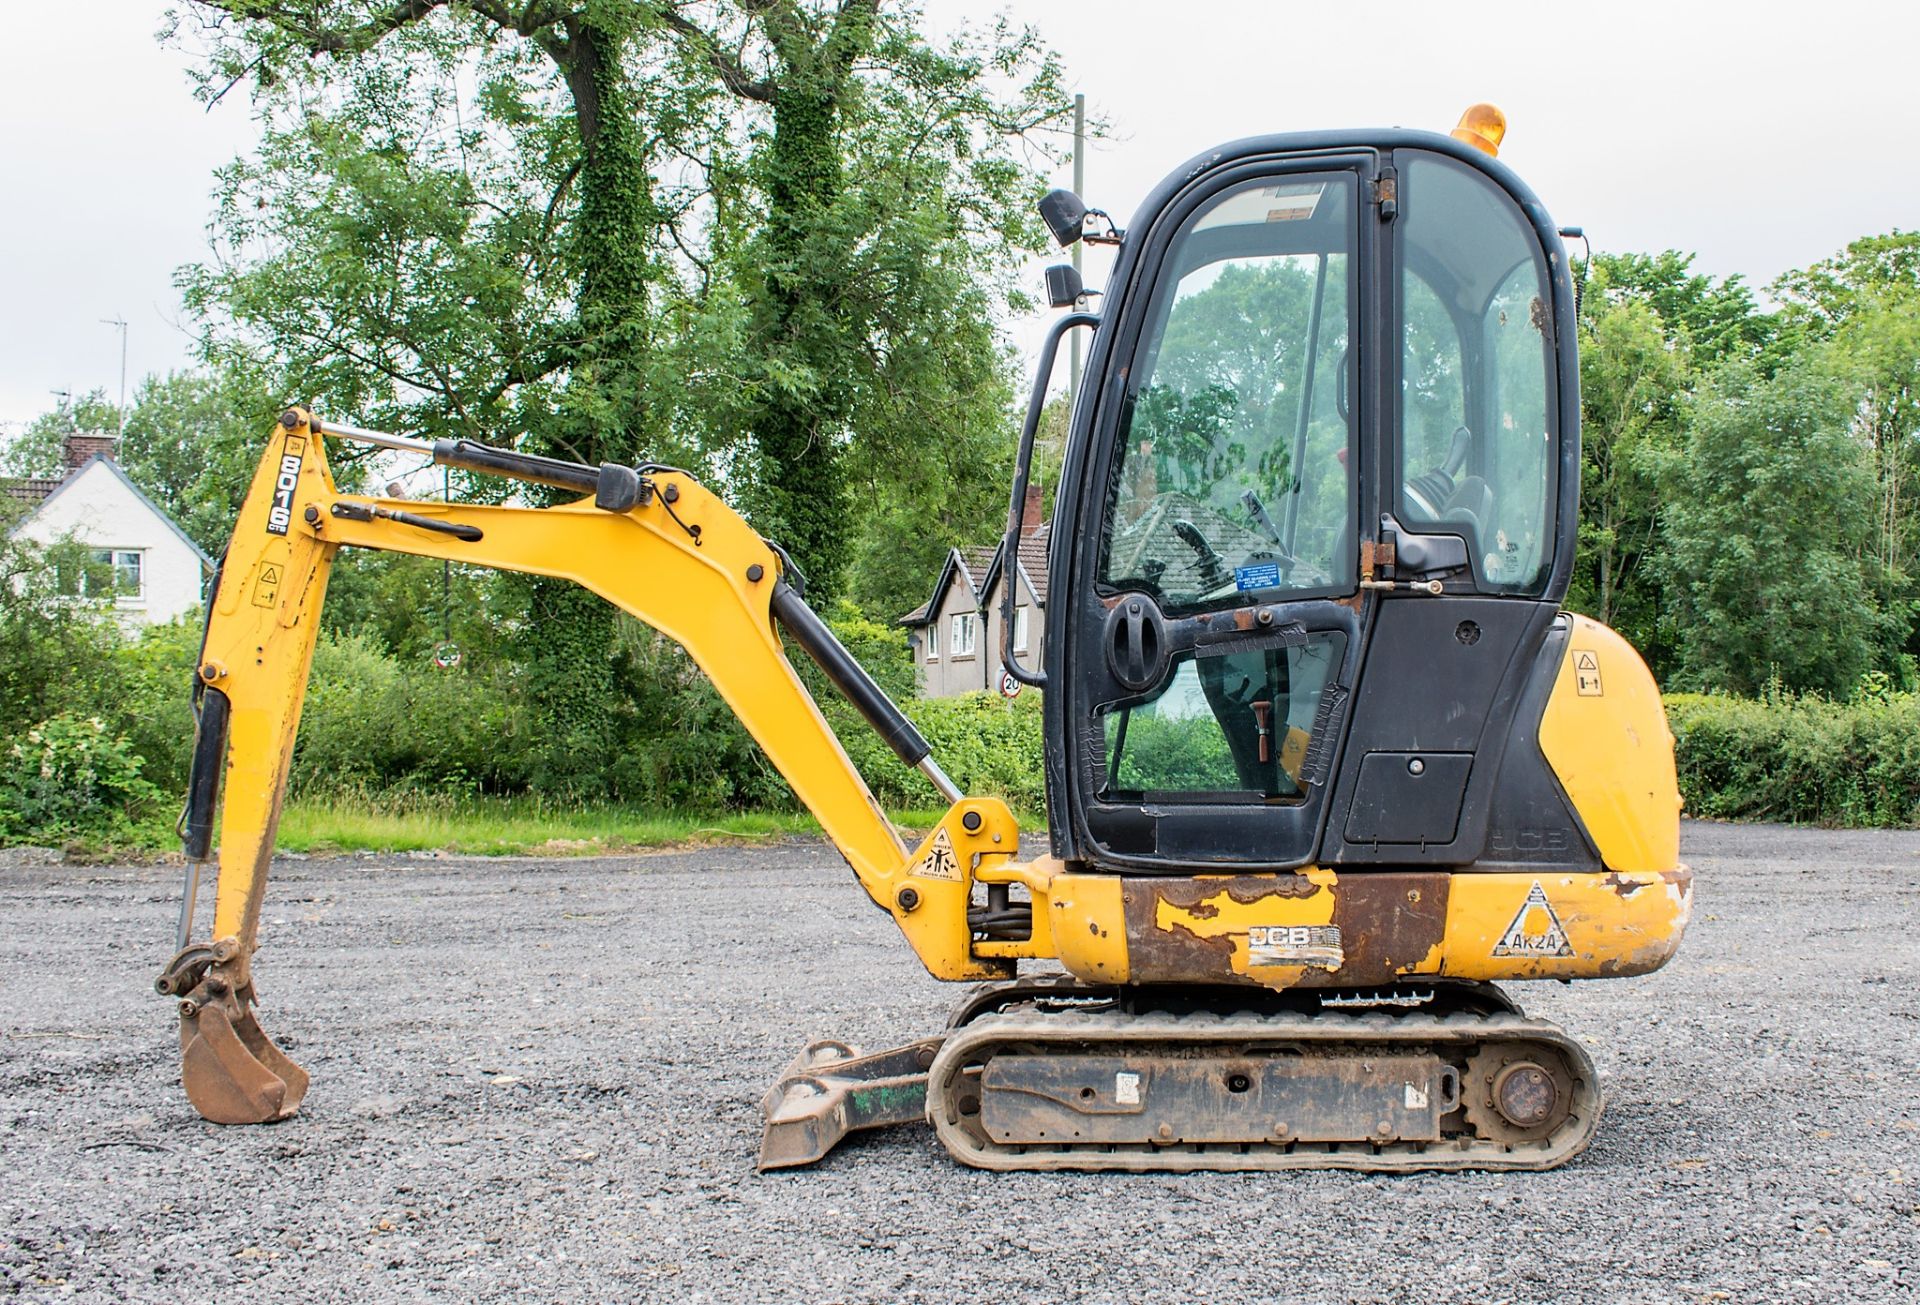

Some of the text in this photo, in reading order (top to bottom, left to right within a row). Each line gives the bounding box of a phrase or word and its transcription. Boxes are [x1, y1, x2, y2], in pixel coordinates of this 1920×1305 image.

[269, 455, 301, 526] 8016
[1005, 678, 1020, 690] 20
[1250, 927, 1310, 945] JCB
